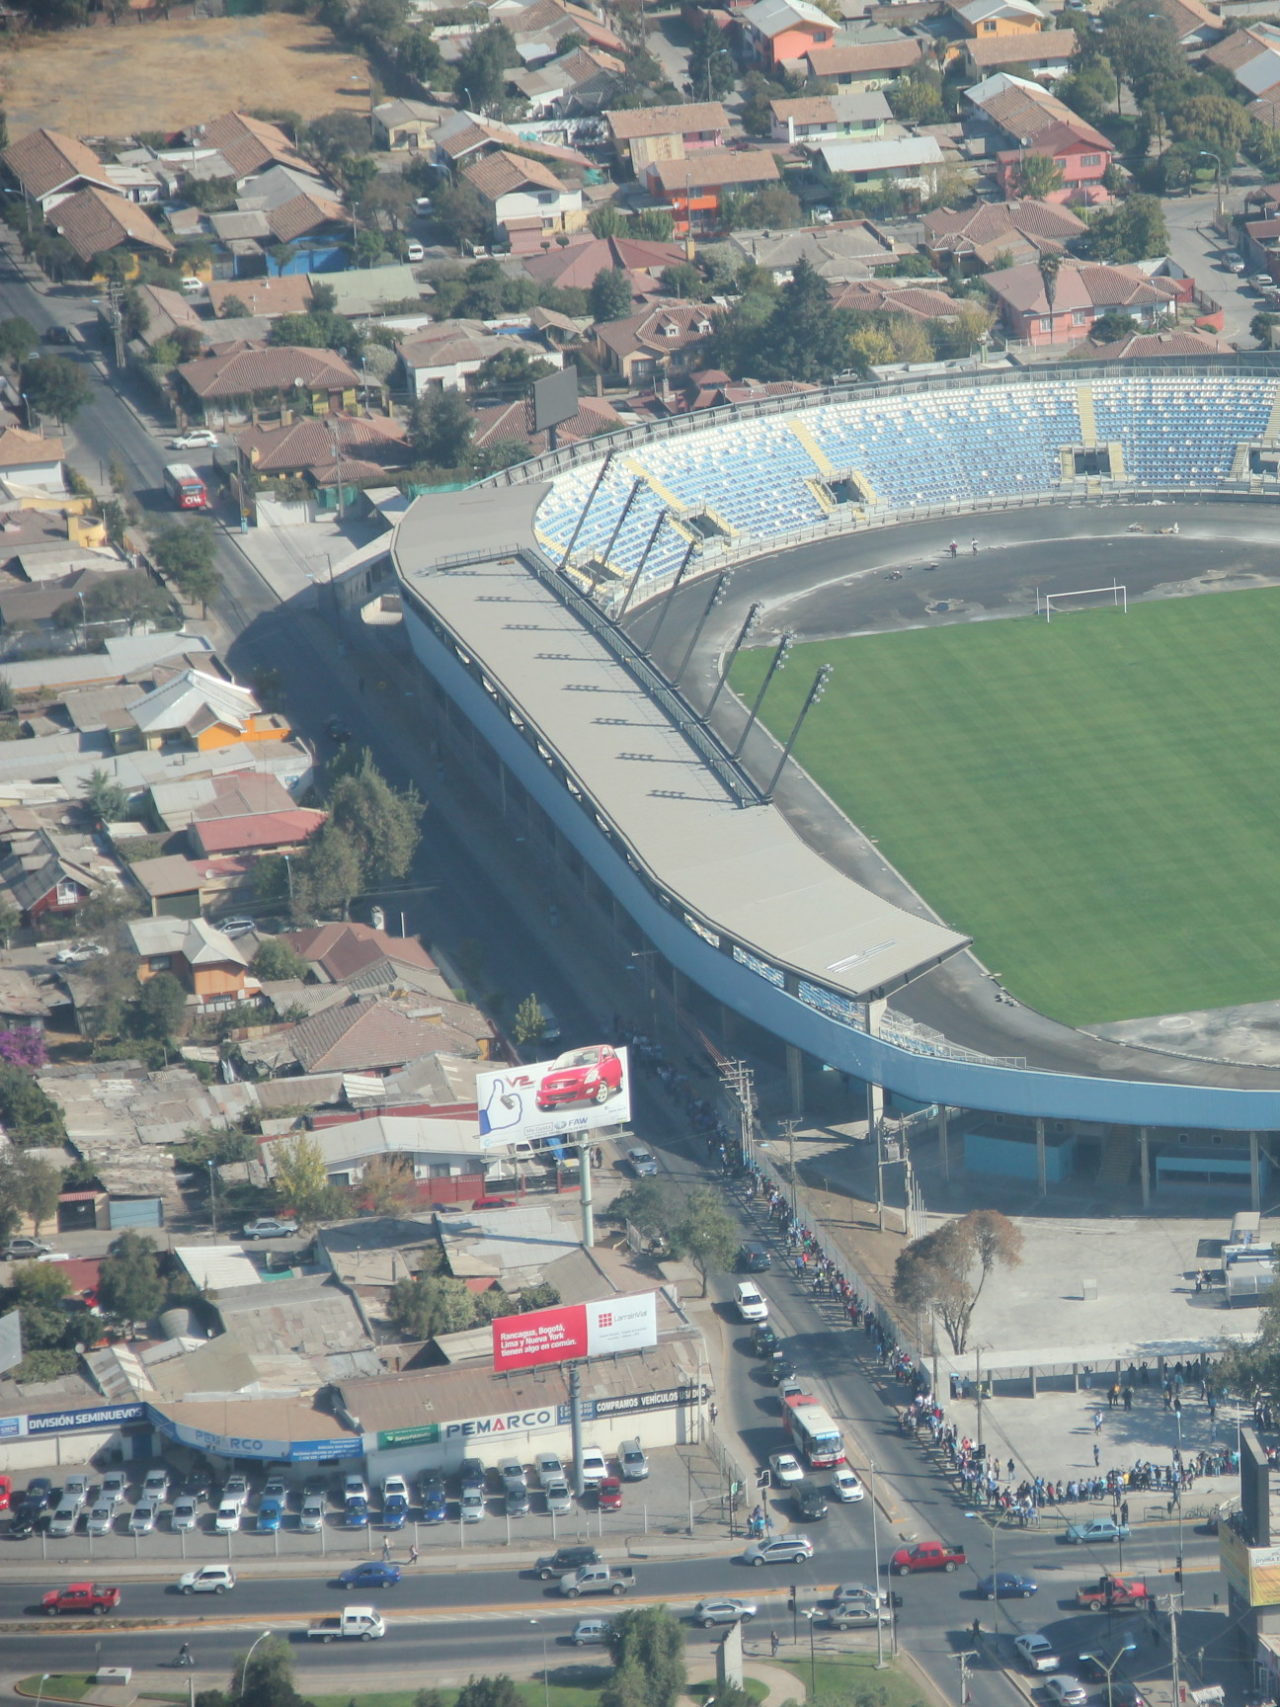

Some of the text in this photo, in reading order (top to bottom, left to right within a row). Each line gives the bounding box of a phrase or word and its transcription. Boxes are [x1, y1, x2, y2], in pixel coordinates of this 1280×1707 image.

[505, 1075, 536, 1087] V2
[568, 1117, 588, 1126] FAW
[539, 1324, 565, 1335] Bogotá,
[501, 1332, 565, 1349] Lima y Nueva York
[501, 1348, 524, 1358] tienen
[525, 1345, 540, 1354] algo
[540, 1343, 550, 1351] en
[596, 1398, 638, 1413] COMPRAMOS
[641, 1391, 678, 1406] VEHÍCULOS
[29, 1415, 74, 1430] DIVISIÓN
[75, 1408, 142, 1424] SEMINUEVOS
[446, 1411, 550, 1438] PEMARCO
[195, 1430, 263, 1451] PEMRCO
